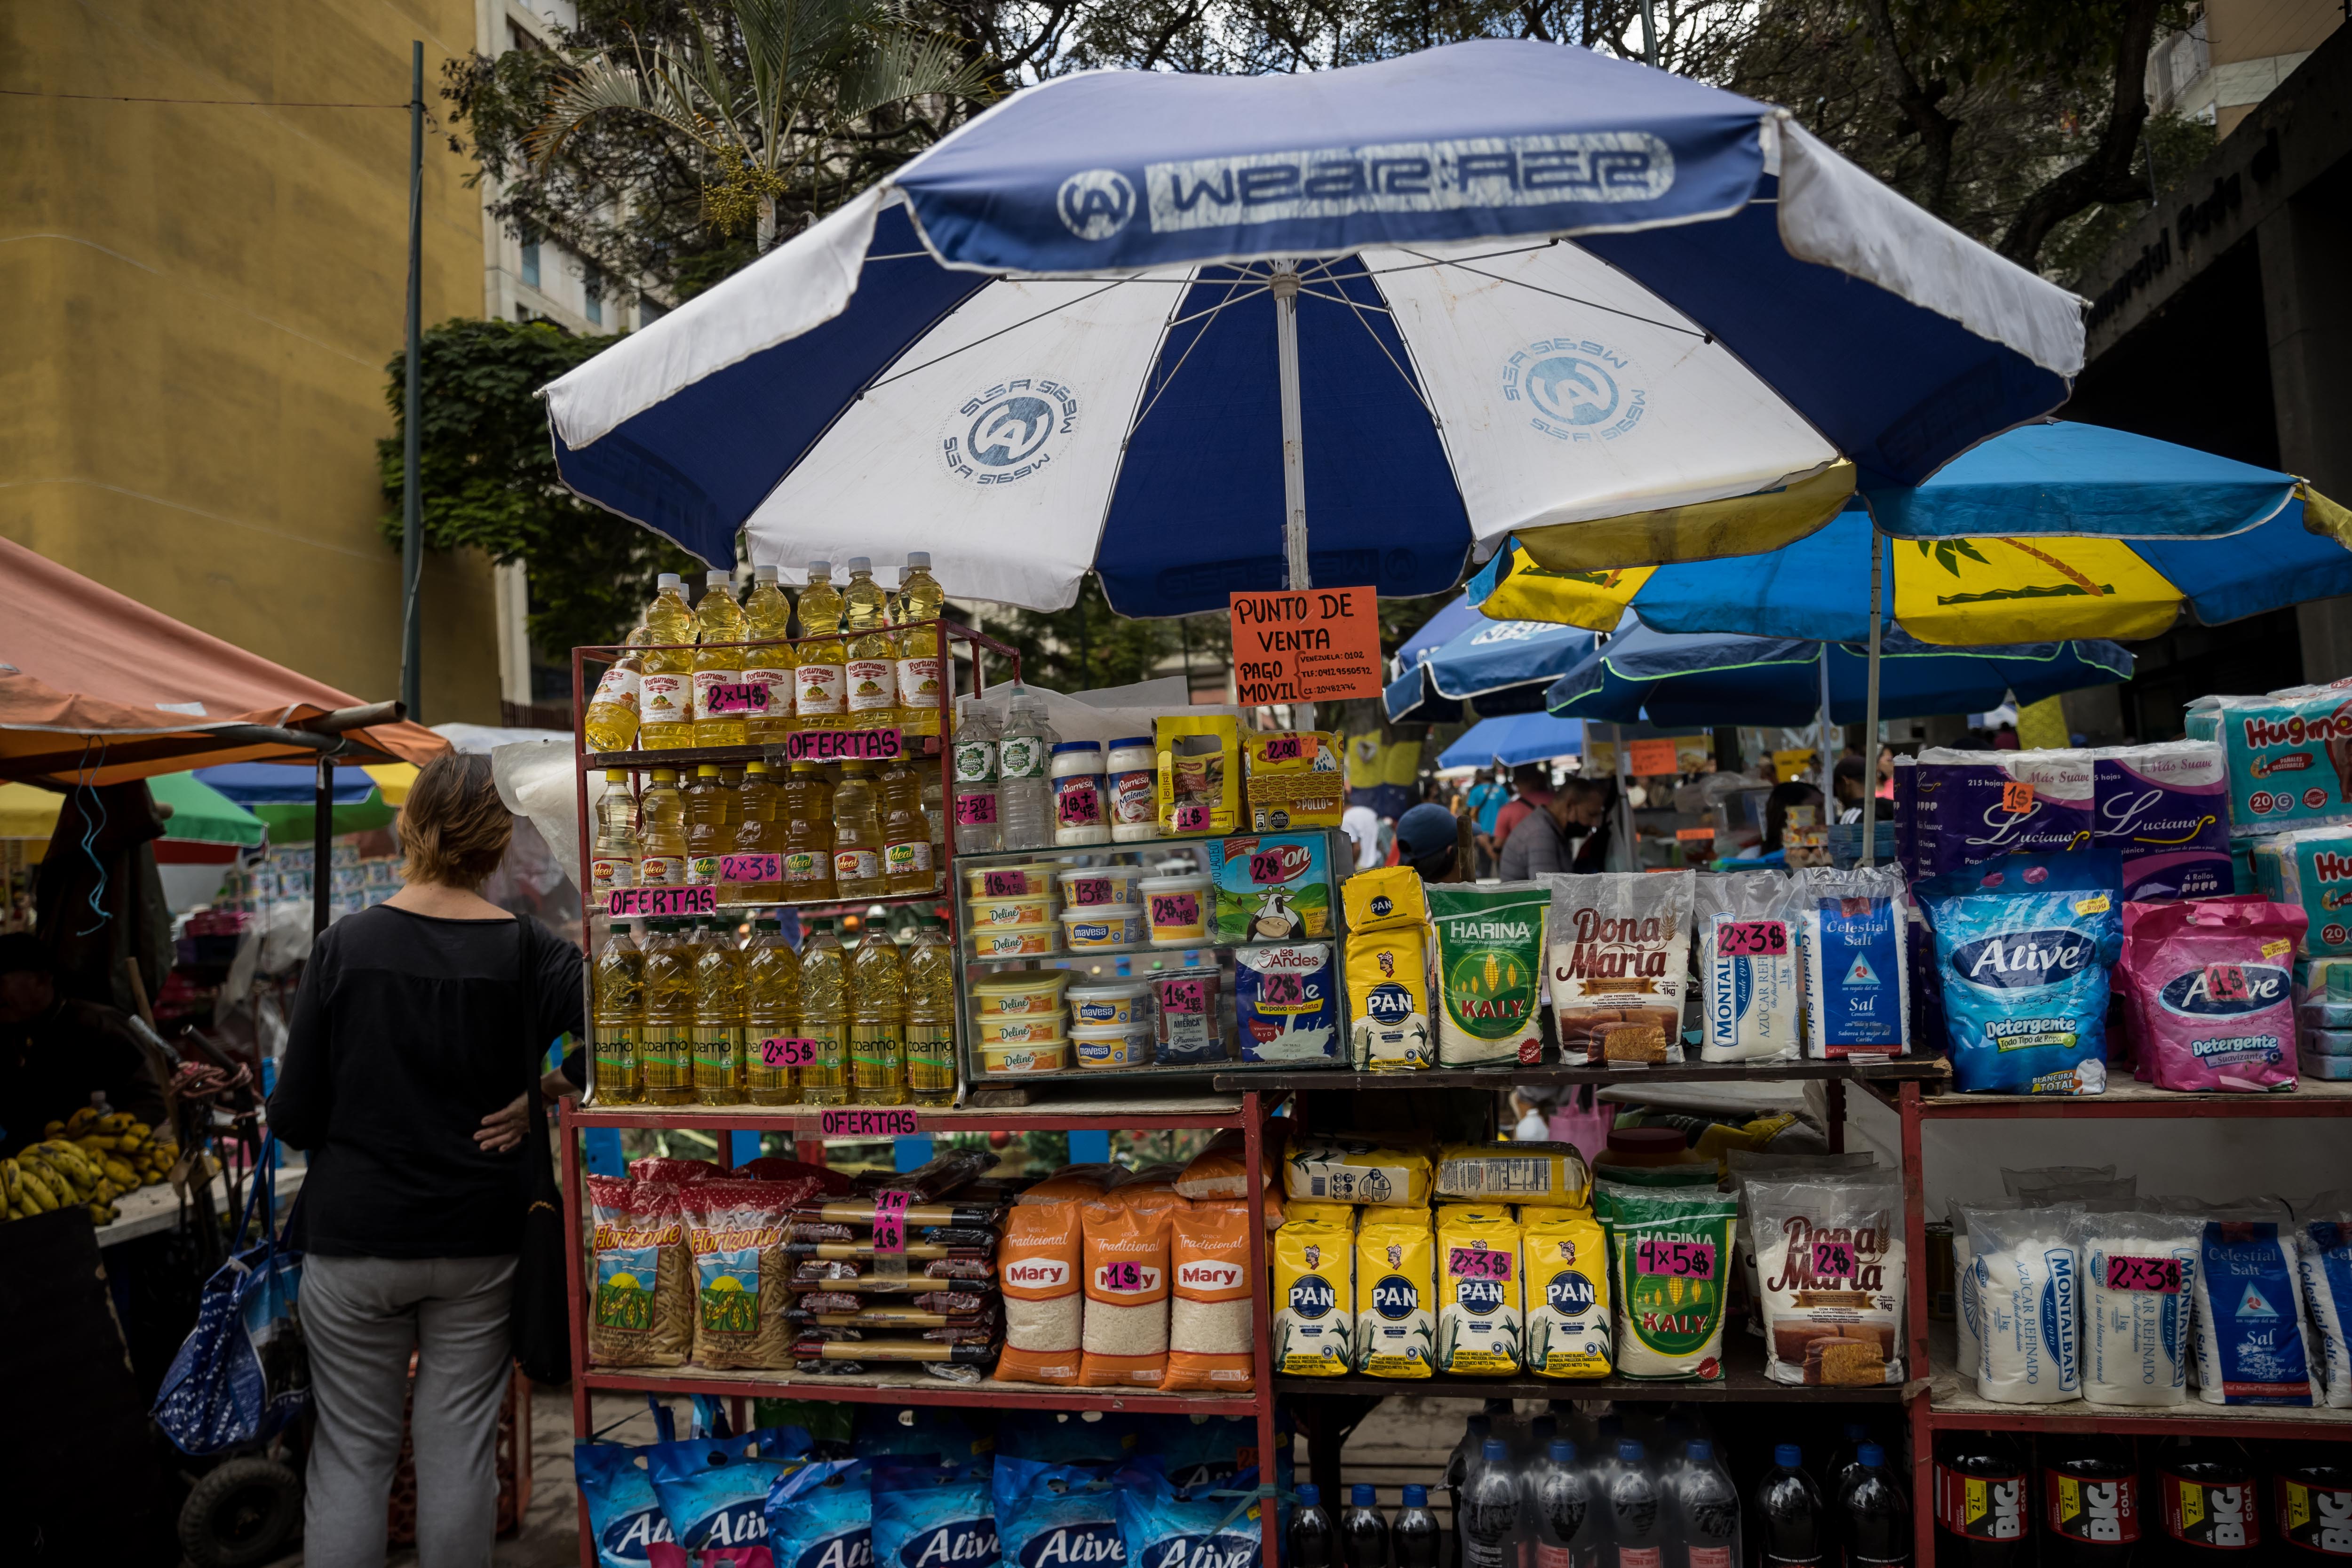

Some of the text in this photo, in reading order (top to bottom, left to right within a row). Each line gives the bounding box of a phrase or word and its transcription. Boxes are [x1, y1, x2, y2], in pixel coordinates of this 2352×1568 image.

[1234, 593, 1354, 624] PUNTO DE
[1257, 628, 1330, 653] VENTA
[798, 666, 833, 679] Portumesa
[849, 661, 886, 675] Portumesa
[1240, 661, 1283, 681] PAGO
[644, 677, 677, 686] Portumesa
[746, 671, 783, 682] Portumesa
[1239, 683, 1297, 702] MOVIL
[789, 731, 898, 758] OFERTAS
[2147, 759, 2213, 773] Más Suave
[2272, 762, 2305, 771] DESECHABLES
[1119, 777, 1149, 792] Pramesa
[2026, 772, 2055, 783] Más
[2059, 771, 2090, 783] Suave
[1120, 788, 1151, 809] Maionese
[1302, 799, 1326, 811] POLLO
[2253, 796, 2271, 807] 20
[2278, 795, 2290, 806] G
[1180, 809, 1202, 827] 1$
[788, 854, 813, 870] Ideal
[837, 854, 859, 870] Ideal
[890, 846, 915, 862] Ideal
[644, 861, 667, 875] Ideal
[1254, 856, 1279, 880] 2$
[611, 889, 714, 915] OFERTAS
[2087, 902, 2107, 913] Ropa
[989, 908, 1019, 921] Deline
[1075, 927, 1106, 938] mavesa
[1450, 921, 1531, 939] HARINA
[1573, 907, 1661, 944] Dona
[1827, 919, 1888, 933] Celestial
[2325, 928, 2344, 939] 20
[992, 938, 1022, 951] Deline
[1844, 934, 1873, 946] Salt
[1271, 953, 1319, 968] Andes
[1556, 942, 1667, 982] Maria
[1970, 939, 2080, 977] Alive
[1267, 974, 1299, 1004] 2$
[1802, 934, 1815, 1029] Celestial Salt
[2210, 968, 2243, 995] 1$
[1662, 987, 1676, 997] 1kg
[999, 998, 1029, 1011] Deline
[1288, 1003, 1319, 1012] completa
[1462, 999, 1525, 1018] KALY
[1849, 995, 1878, 1011] Sal
[1081, 1008, 1113, 1018] mavesa
[1757, 988, 1770, 1038] AZÚCAR
[1000, 1027, 1030, 1040] Deline
[1985, 1018, 2076, 1038] Detergente
[644, 1041, 688, 1052] coamo
[852, 1040, 896, 1051] coamo
[908, 1040, 954, 1052] coamo
[1173, 1035, 1203, 1045] Premium
[2001, 1039, 2018, 1048] Todo
[2018, 1037, 2033, 1046] Tipo
[2043, 1035, 2062, 1044] Ropa
[2192, 1035, 2278, 1057] Detergente
[1080, 1047, 1108, 1056] mavesa
[2217, 1053, 2264, 1064] Suavizante
[1003, 1054, 1034, 1067] Deline
[2032, 1072, 2074, 1084] BLANCURA
[2040, 1080, 2074, 1092] TOTAL
[823, 1112, 915, 1133] OFERTAS
[593, 1223, 681, 1257] Horizonte
[690, 1226, 781, 1256] Horizonte
[874, 1227, 898, 1248] 1$
[1006, 1231, 1068, 1250] Tradicional
[1097, 1238, 1160, 1253] Tradicional
[1178, 1234, 1243, 1250] Tradicional
[1817, 1244, 1850, 1275] 2$
[2208, 1247, 2277, 1262] Celestial
[1011, 1266, 1063, 1283] Mary
[1109, 1264, 1138, 1289] 1$
[1183, 1268, 1237, 1285] Mary
[2230, 1263, 2260, 1276] Salt
[2300, 1262, 2329, 1334] Celestial
[1880, 1302, 1893, 1312] 1kg
[1644, 1312, 1707, 1334] KALY
[2015, 1260, 2039, 1384] AZÚCAR REFINADO
[2052, 1258, 2074, 1383] MONTALBAN
[2177, 1257, 2195, 1380] MONTALBAN
[2246, 1328, 2277, 1345] Sal
[2143, 1318, 2155, 1384] REFINADO
[2120, 1482, 2130, 1517] COLA
[1994, 1479, 2020, 1538] BIG
[2087, 1482, 2121, 1541] BIG
[2211, 1486, 2246, 1546] BIG
[2318, 1491, 2352, 1552] BIG
